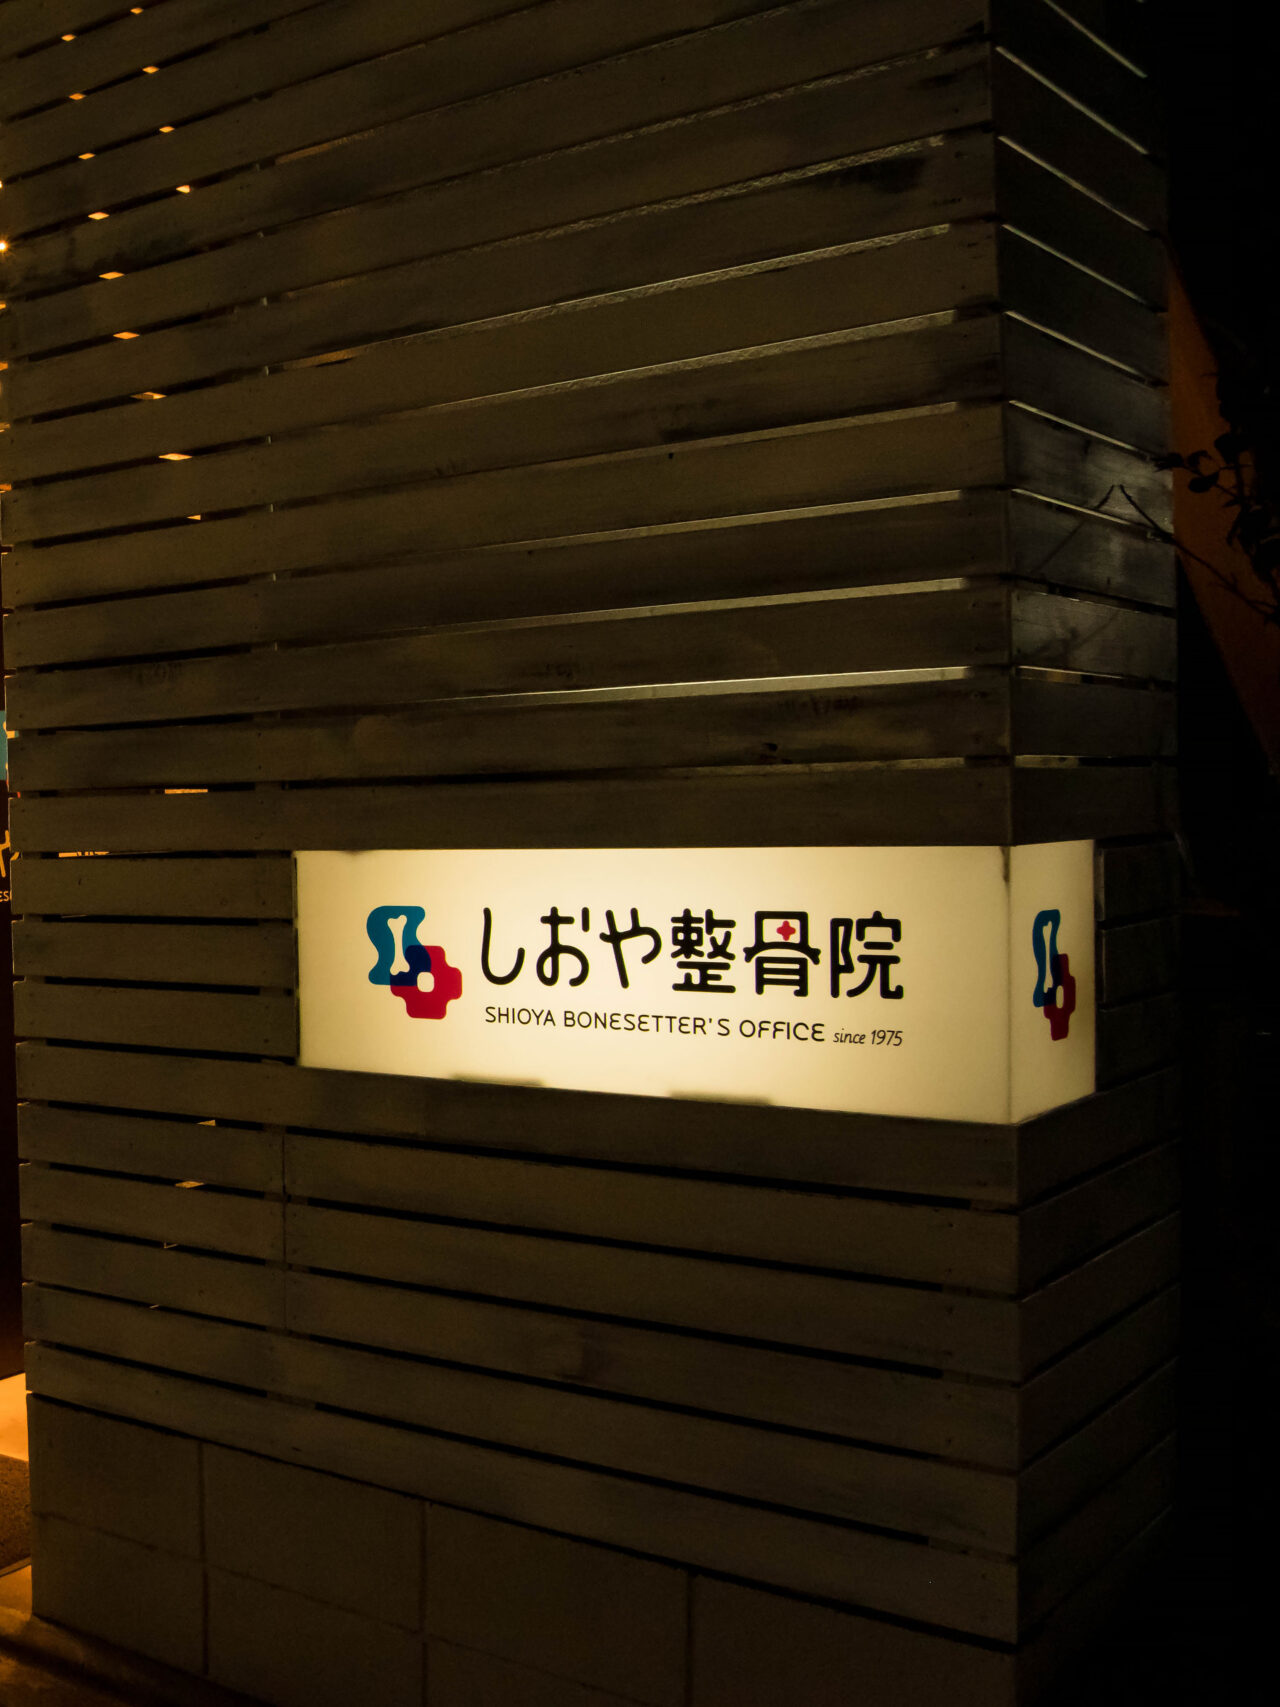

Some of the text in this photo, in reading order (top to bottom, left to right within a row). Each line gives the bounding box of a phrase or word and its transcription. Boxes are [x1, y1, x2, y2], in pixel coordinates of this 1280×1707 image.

[481, 906, 905, 1000] しおや整骨院
[484, 1005, 904, 1047] SHIOYA BONESETTER'S OFFICE since 1975
